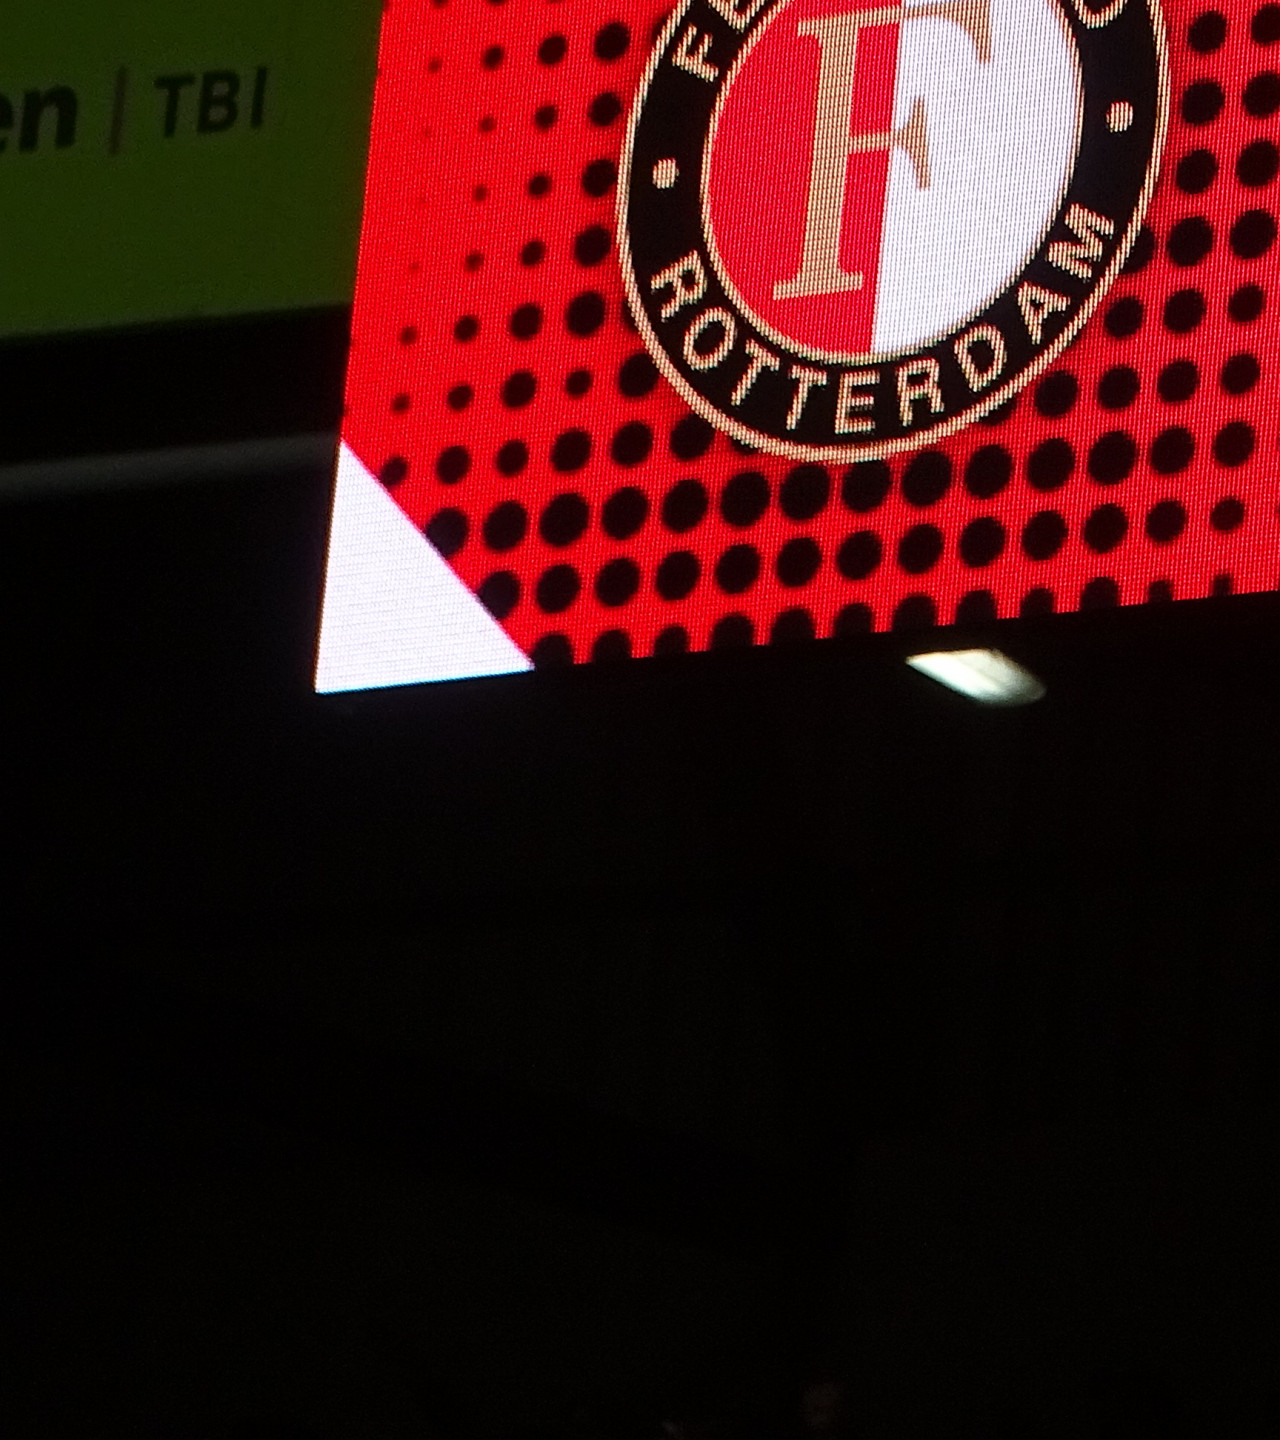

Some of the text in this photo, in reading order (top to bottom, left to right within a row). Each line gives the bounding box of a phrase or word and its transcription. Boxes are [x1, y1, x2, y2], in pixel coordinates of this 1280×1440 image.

[0, 66, 268, 153] n TBI
[652, 204, 1114, 434] ROTTERDAM
